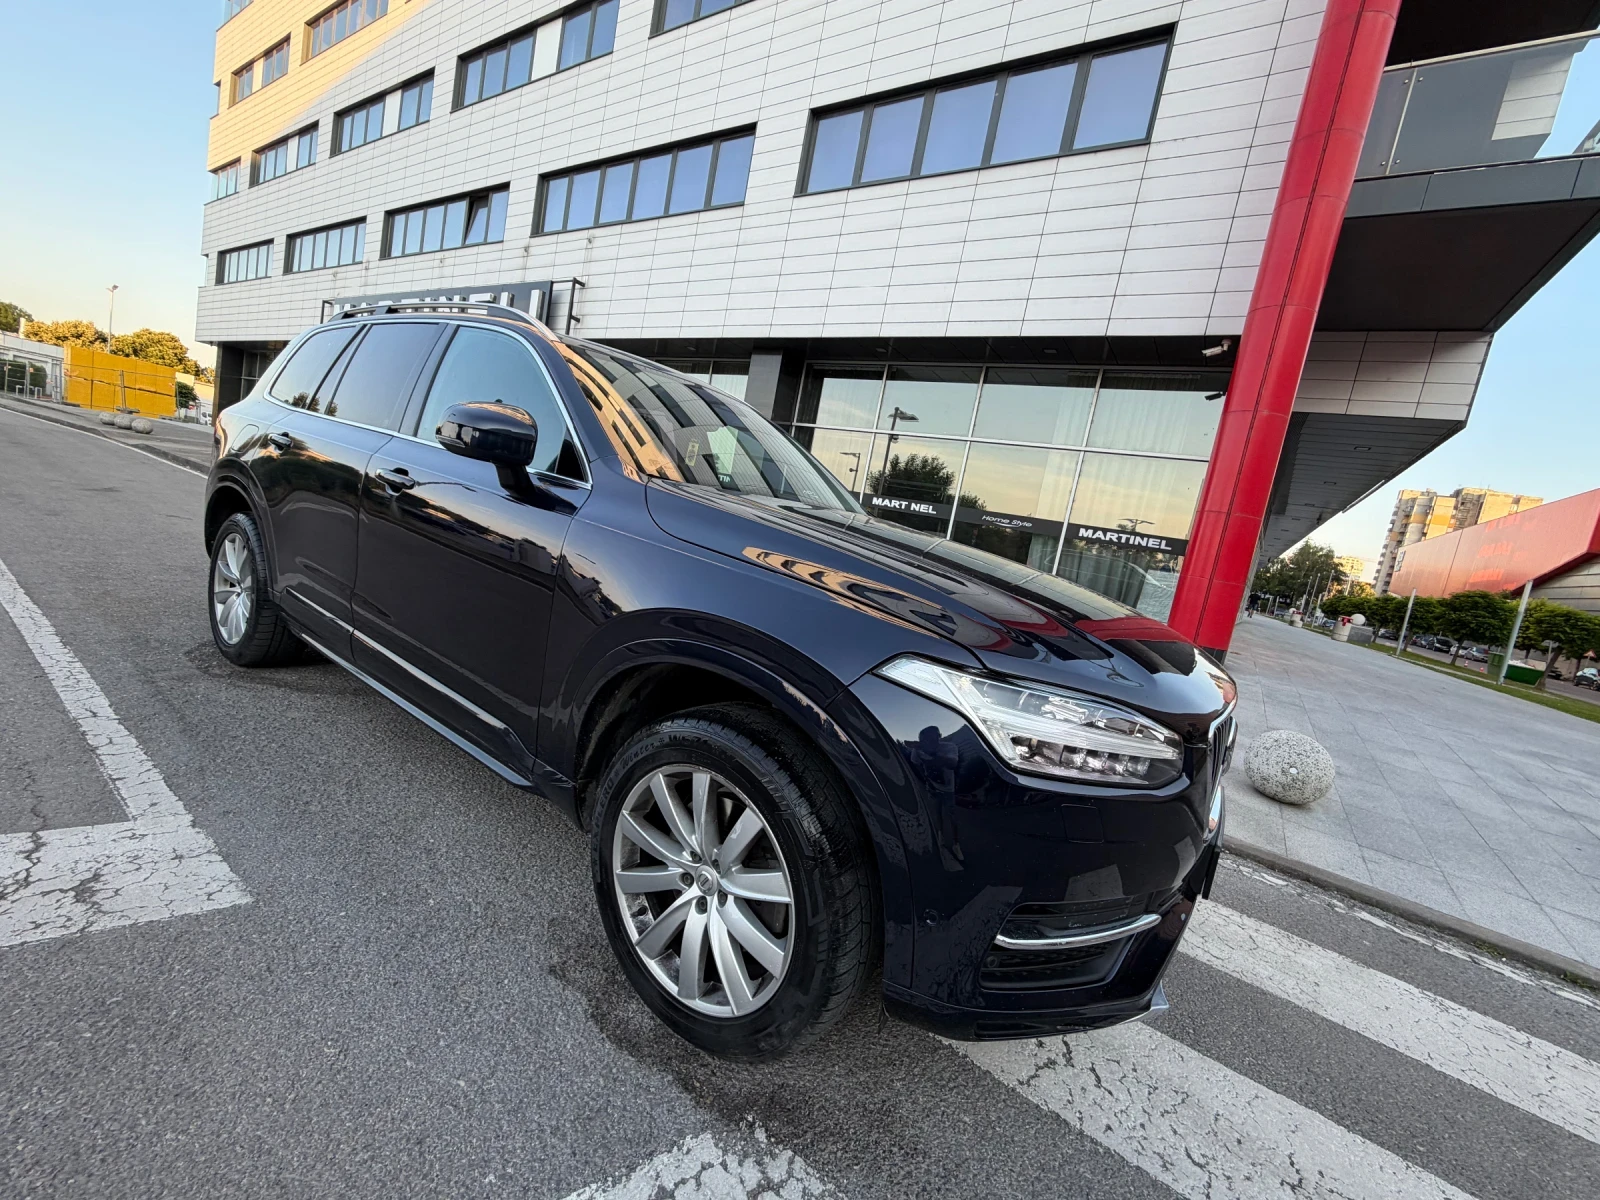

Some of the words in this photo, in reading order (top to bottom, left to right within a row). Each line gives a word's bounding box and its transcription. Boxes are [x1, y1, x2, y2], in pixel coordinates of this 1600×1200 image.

[981, 515, 1010, 524] Home
[1011, 519, 1033, 528] Style
[1078, 527, 1172, 550] MARTINEL
[621, 742, 656, 770] Winter
